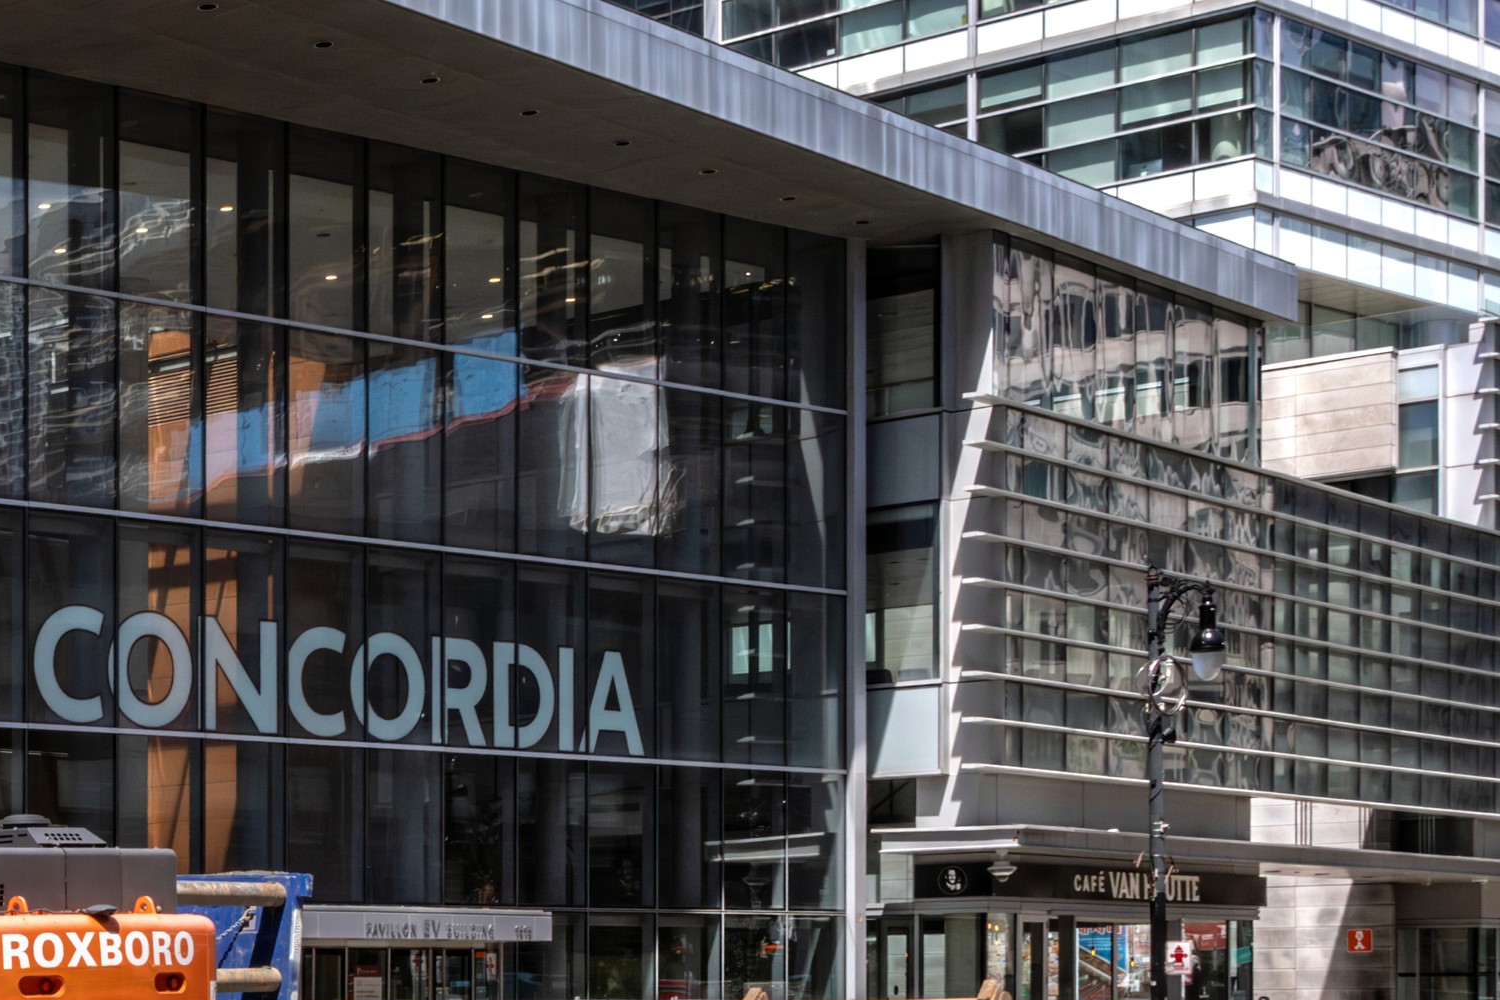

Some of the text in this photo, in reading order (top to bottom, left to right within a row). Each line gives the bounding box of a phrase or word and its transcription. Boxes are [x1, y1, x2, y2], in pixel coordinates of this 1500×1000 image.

[33, 604, 645, 757] CONCORDIA
[1073, 870, 1106, 893] CAFÉ
[1109, 871, 1140, 899] VAN
[365, 921, 417, 939] PAVILLON
[445, 922, 495, 940] BUILDING
[1, 930, 196, 971] ROXBORO
